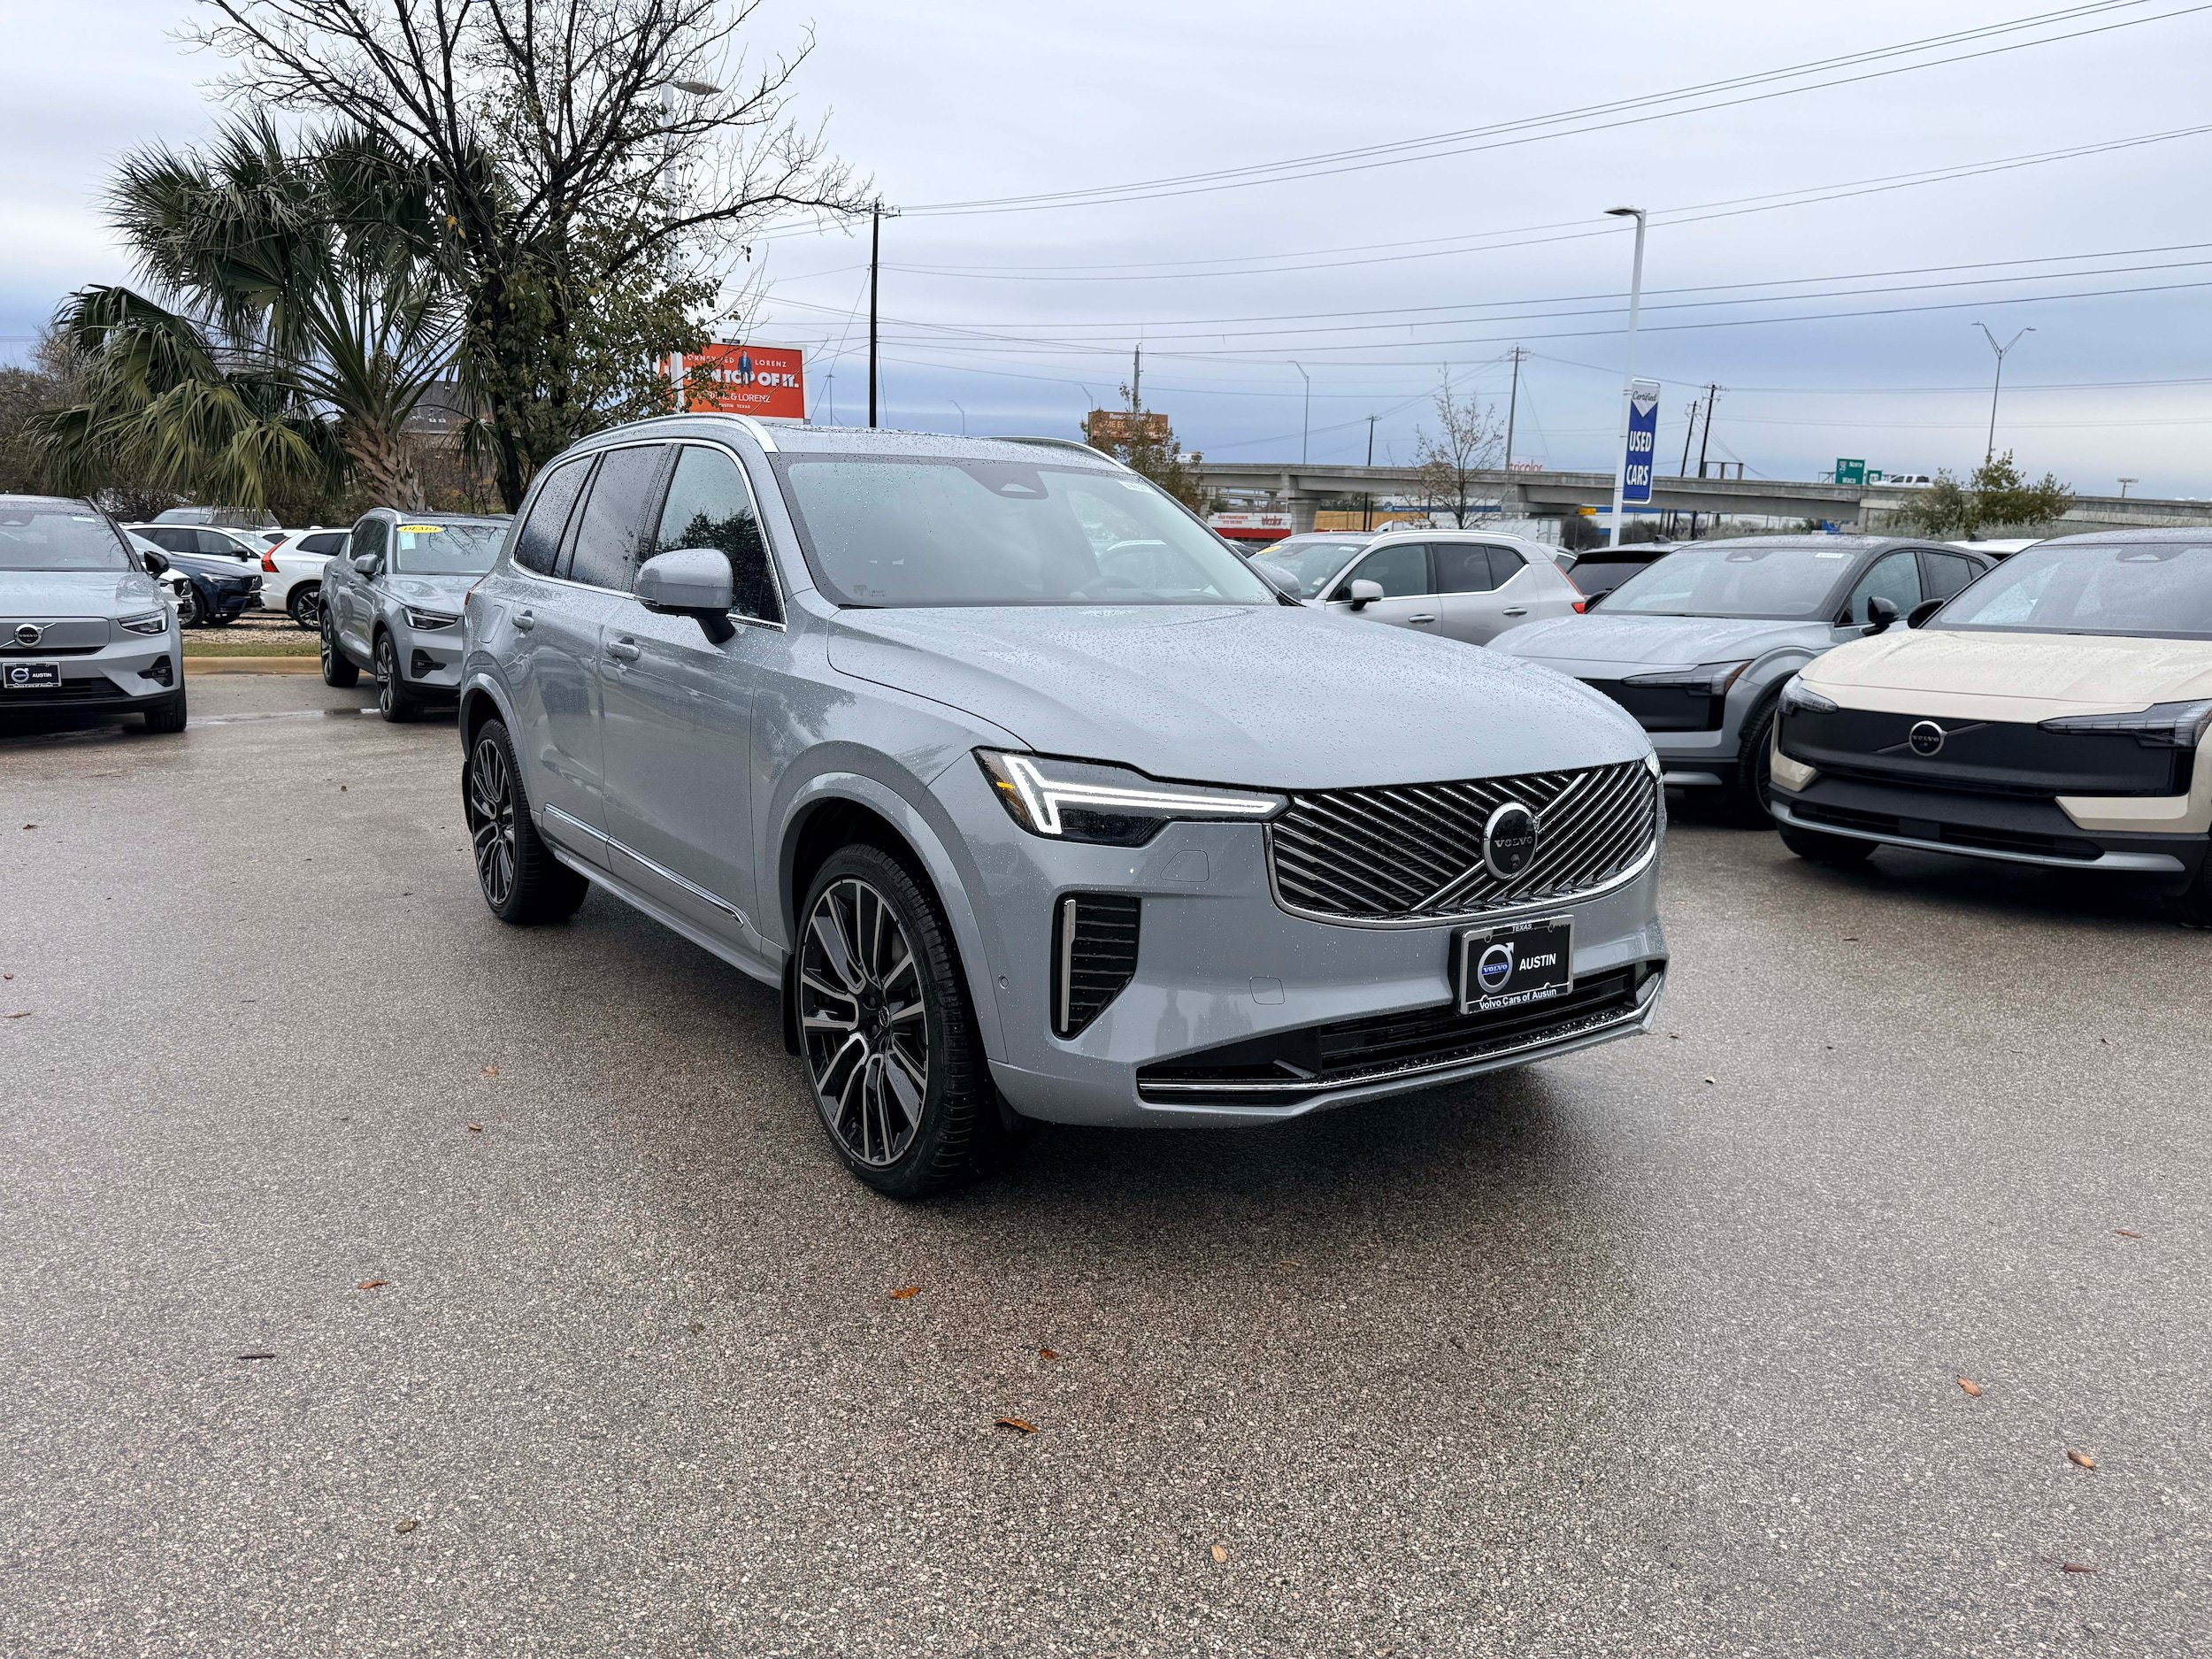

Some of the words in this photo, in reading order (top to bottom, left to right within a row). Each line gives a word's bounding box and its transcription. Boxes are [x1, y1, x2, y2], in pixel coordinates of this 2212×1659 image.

[755, 358, 787, 368] LORENZ
[757, 372, 781, 387] OF
[782, 374, 800, 388] IT.
[738, 393, 771, 403] LORENZ
[1632, 390, 1657, 402] Certified
[1629, 430, 1652, 452] USED
[1625, 464, 1649, 487] CARS
[1494, 835, 1533, 848] VOLVO
[1512, 923, 1532, 933] TEXAS
[1483, 964, 1509, 973] VOLVO
[1518, 953, 1556, 972] AUSTIN
[1479, 999, 1502, 1010] Volvo
[1502, 995, 1521, 1006] Cars
[1522, 992, 1531, 1002] of
[1532, 988, 1557, 1000] Austin
